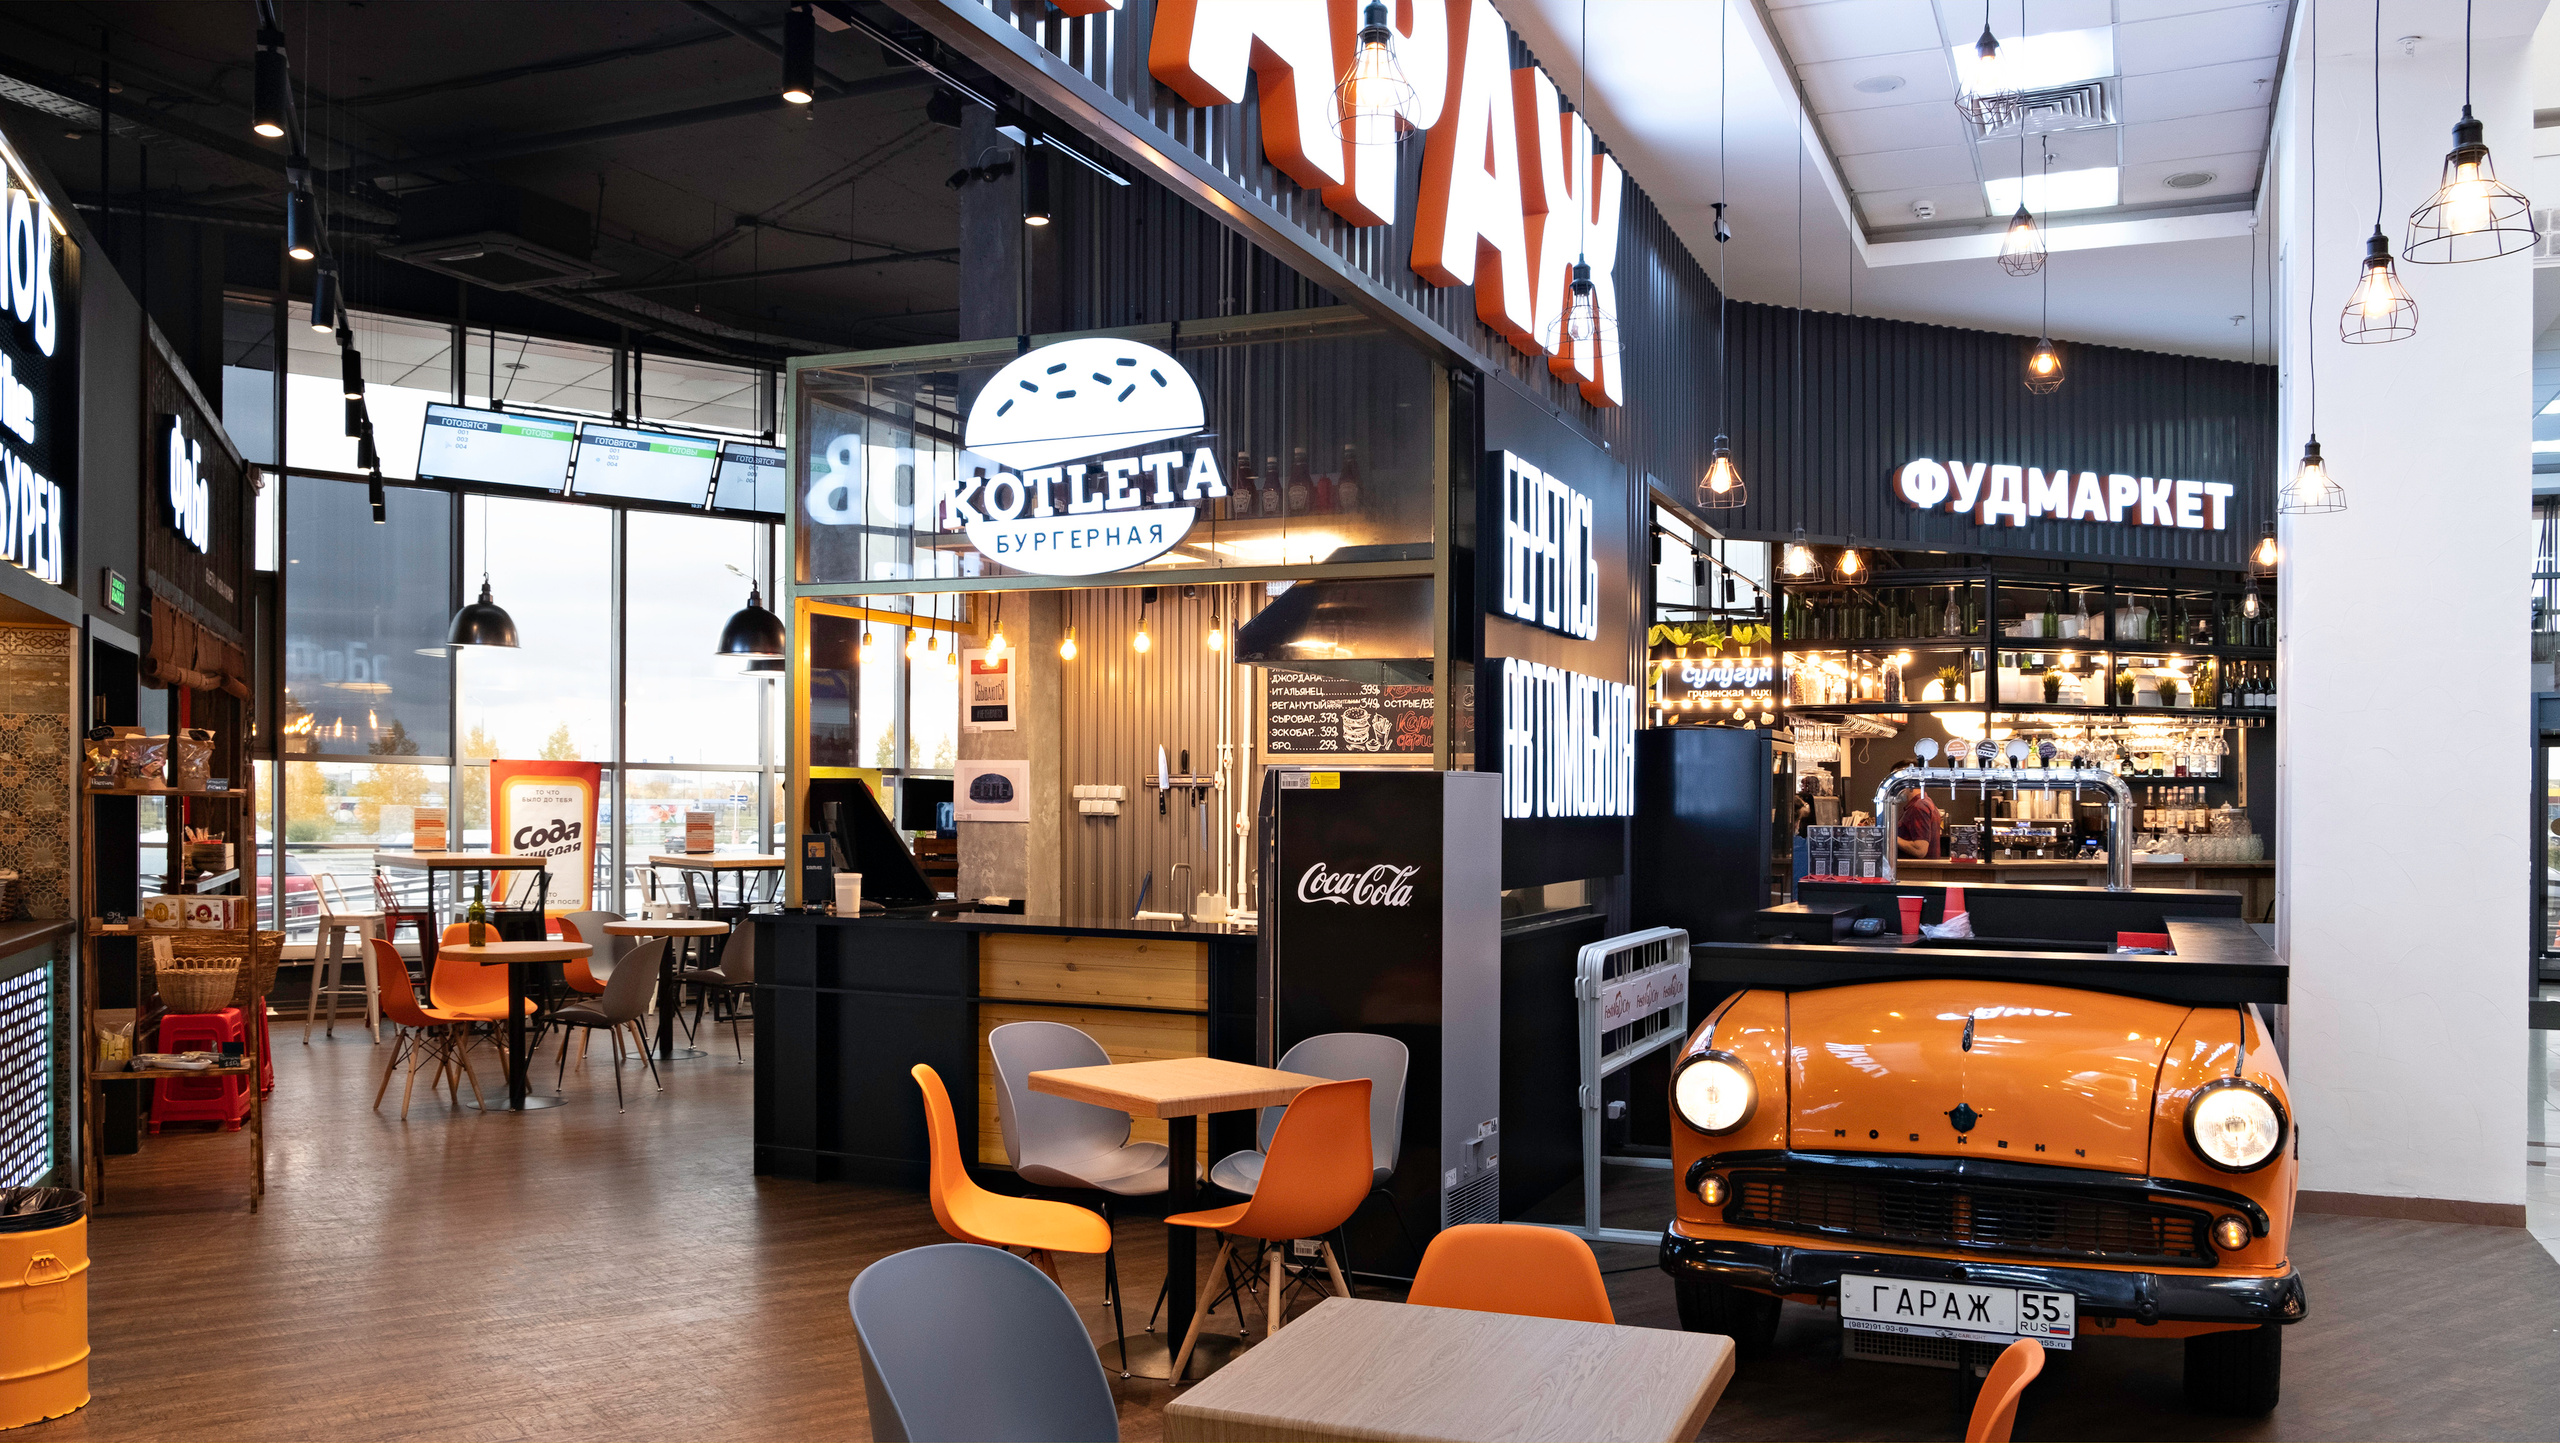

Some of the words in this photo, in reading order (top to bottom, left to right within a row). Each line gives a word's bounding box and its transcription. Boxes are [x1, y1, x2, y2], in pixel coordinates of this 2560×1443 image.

[1075, 0, 1623, 407] РАЖ
[0, 157, 56, 357] ОВ
[441, 417, 488, 430] ГОТОВЯТСЯ
[521, 427, 554, 439] ГОТОВЫ
[595, 437, 638, 449] ГОТОВЯТСЯ
[668, 445, 698, 456] ГОТОВЫ
[942, 447, 1228, 529] KOTLETA
[1900, 457, 2234, 531] ФУДМАРКЕТ
[996, 523, 1164, 553] БУРГЕРНАЯ
[1503, 449, 1598, 641] БЕРЕГИСЬ
[1271, 673, 1322, 684] ДЖОРДАНА
[1271, 687, 1324, 697] ИТАЛЬЯНЕЦ
[1687, 689, 1744, 700] грузинская
[1750, 690, 1771, 700] кух
[1271, 699, 1327, 710] ВЕГАНУТЫЙ
[1271, 715, 1315, 724] СЫРОВАР
[1271, 728, 1314, 737] ЭСКОБАР
[1503, 656, 1636, 818] АВТОМОБИЛЯ
[1271, 741, 1290, 750] БРО
[513, 818, 582, 850] Сода
[1297, 862, 1421, 907] Coca-Cola
[1873, 1285, 1991, 1323] ГАРАЖ
[2022, 1293, 2060, 1323] 55
[2019, 1321, 2048, 1333] RUS
